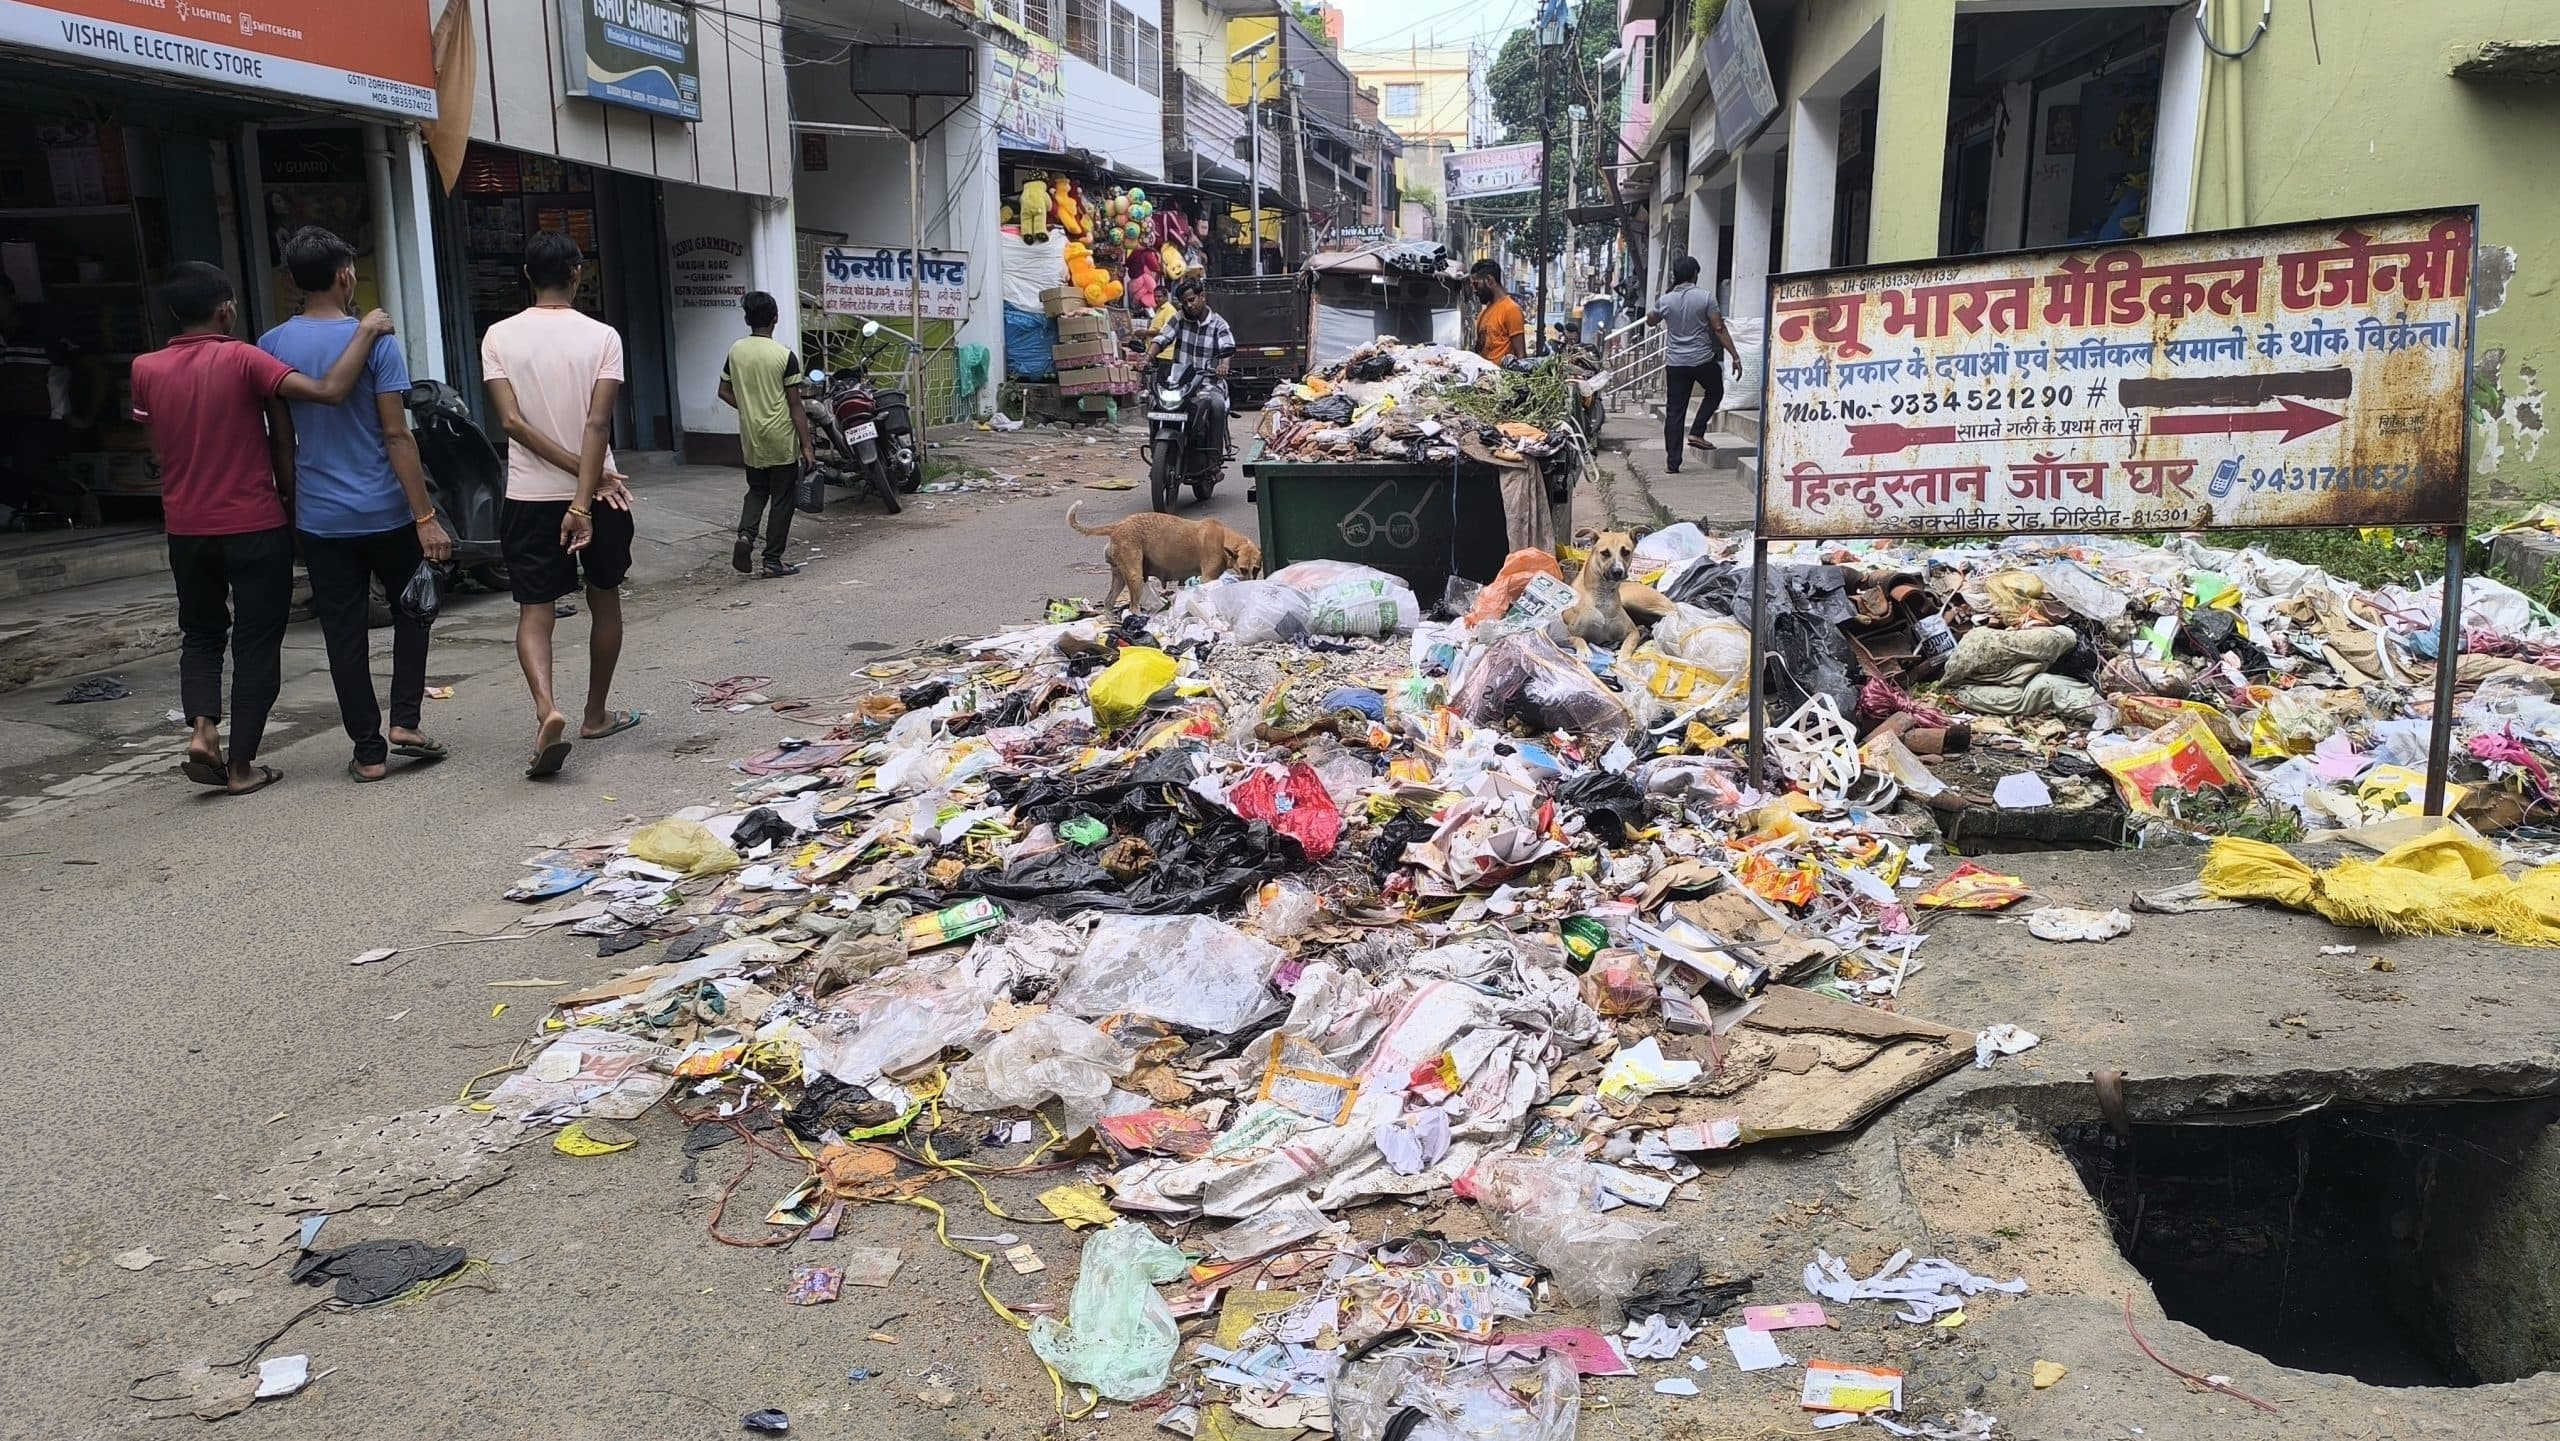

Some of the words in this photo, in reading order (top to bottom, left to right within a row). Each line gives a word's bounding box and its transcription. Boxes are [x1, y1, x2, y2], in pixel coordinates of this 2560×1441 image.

[191, 9, 232, 24] LIGHTING
[252, 20, 303, 40] SWITCHGEAR
[626, 0, 689, 44] GARMENTS
[62, 20, 130, 53] VISHAL
[134, 35, 210, 68] ELECTRIC
[214, 52, 263, 79] STORE
[708, 260, 728, 270] ROAD
[824, 248, 895, 282] फैन्सी
[1777, 294, 1873, 359] न्यू
[1881, 277, 2036, 339] भारत
[2043, 250, 2265, 328] मेडिकल
[2277, 217, 2472, 311] एजेन्सी
[1776, 355, 1831, 392] सभी
[1836, 359, 1903, 390] प्रकार
[1906, 346, 1929, 380] के
[1935, 341, 2010, 382] दवाओं
[2014, 340, 2049, 379] एवं
[2054, 337, 2155, 371] सर्जिकल
[2163, 325, 2248, 367] समानो
[2257, 322, 2282, 359] के
[2290, 317, 2349, 357] थोक
[1783, 400, 1837, 423] Mob.
[1890, 385, 2073, 415] 9334521290
[1957, 417, 2000, 442] सामने
[2007, 416, 2040, 436] गली
[2042, 415, 2056, 435] के
[2058, 419, 2096, 437] प्रथम
[2100, 418, 2125, 434] तल
[2127, 412, 2143, 434] में
[1784, 461, 1991, 519] हिन्दुस्तान
[2006, 451, 2110, 500] जाँच
[2120, 459, 2199, 500] घर
[1909, 508, 2000, 531] बक्सीडीह
